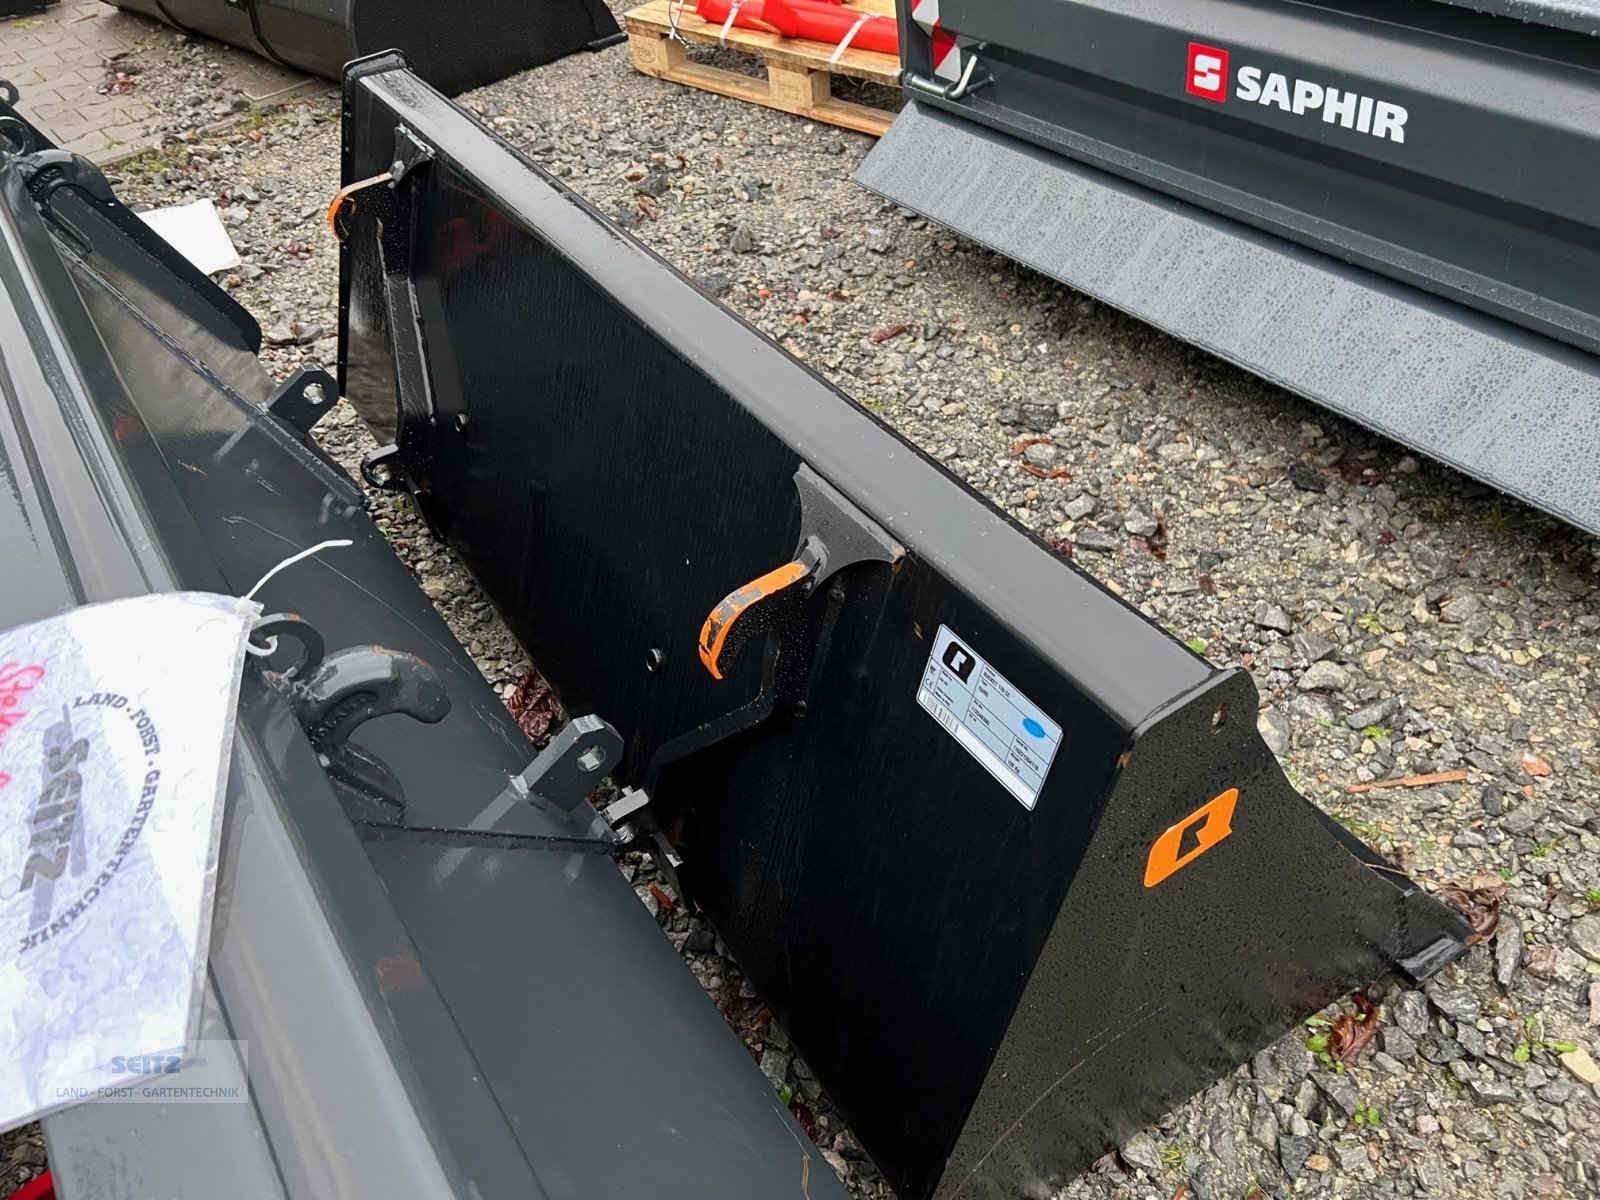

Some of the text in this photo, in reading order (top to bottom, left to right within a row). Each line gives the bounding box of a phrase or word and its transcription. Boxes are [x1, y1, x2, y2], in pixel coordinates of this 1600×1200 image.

[1236, 66, 1408, 144] SAPHIR
[982, 671, 997, 687] BUCKET
[18, 692, 161, 954] LAND FORST GARTENTECHNIK
[19, 736, 90, 893] SEITZ
